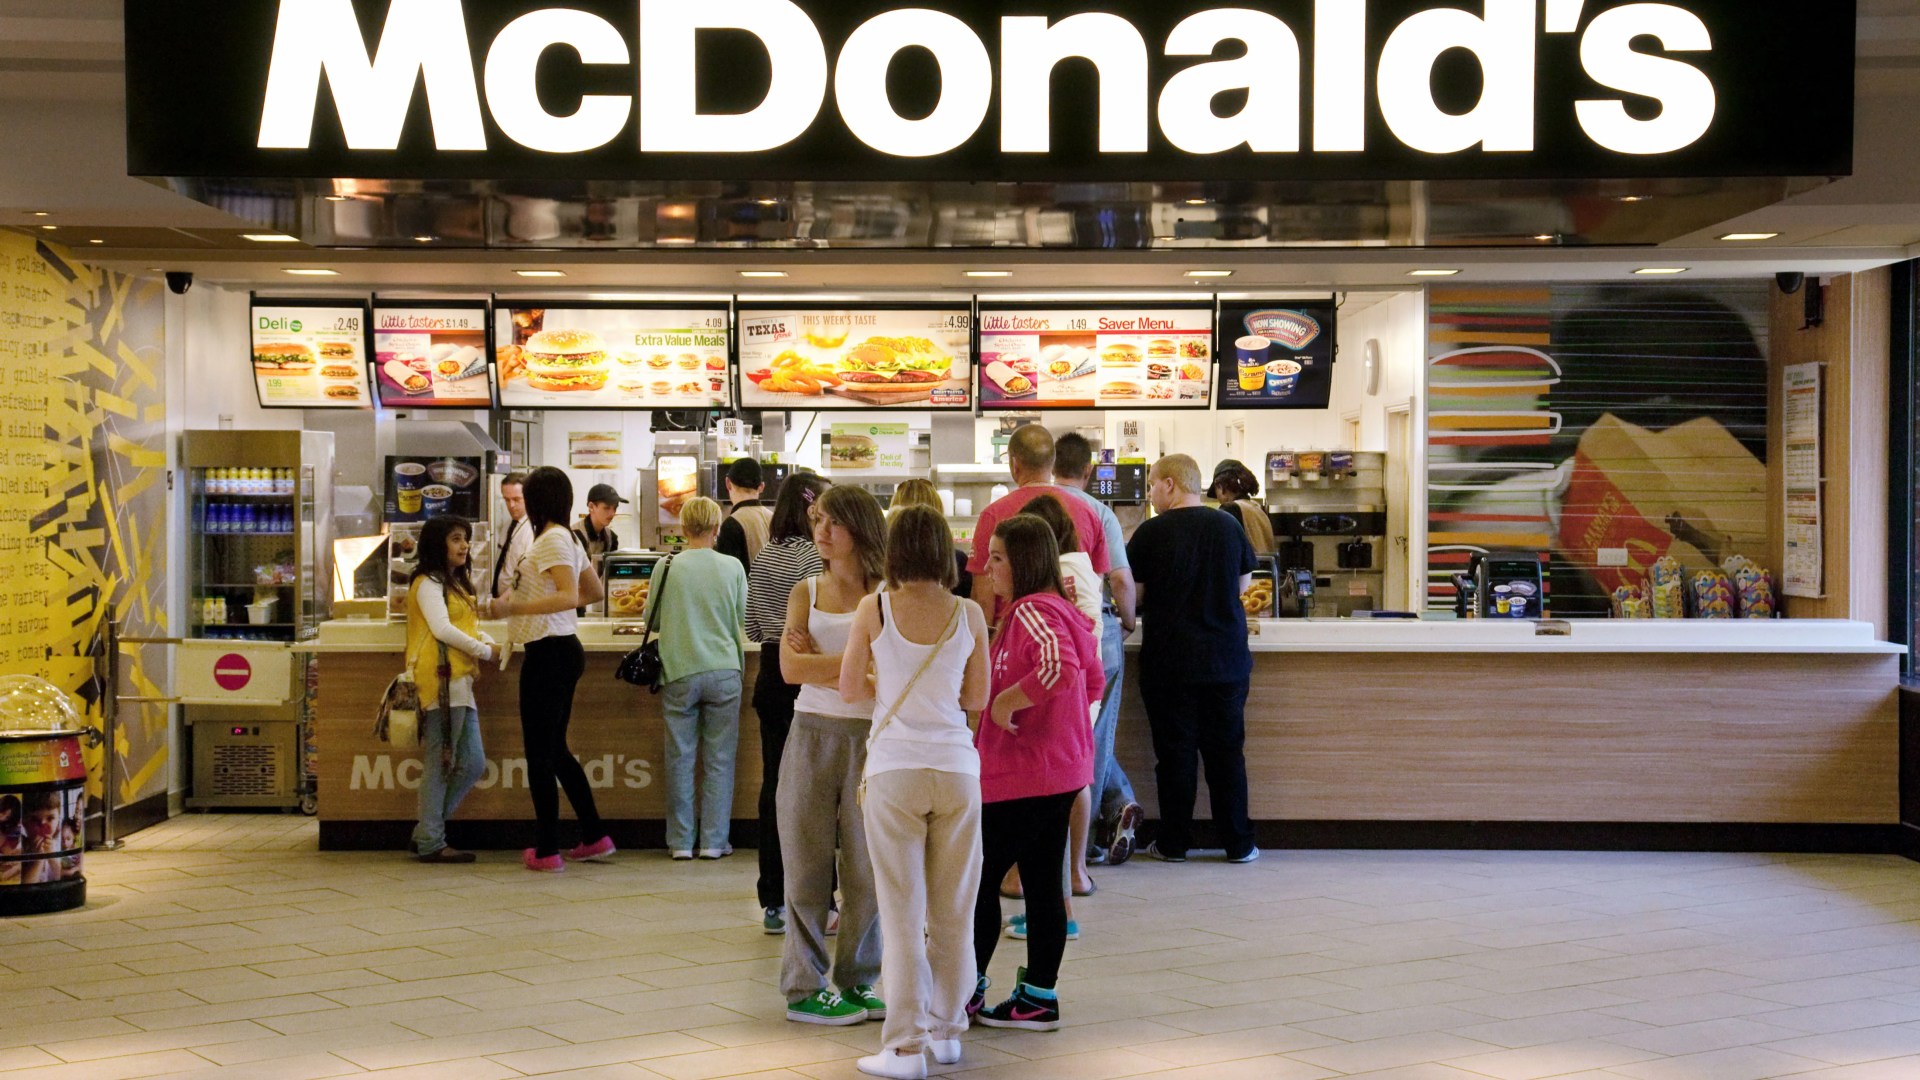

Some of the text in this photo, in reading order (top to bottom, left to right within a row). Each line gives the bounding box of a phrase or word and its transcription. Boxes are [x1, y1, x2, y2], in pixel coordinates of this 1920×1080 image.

[257, 0, 1717, 158] McDonald's
[259, 316, 288, 330] Deli
[408, 314, 445, 329] tasters
[445, 318, 469, 329] £1.49
[802, 315, 877, 325] THIS WEEK'S TASTE
[944, 315, 969, 329] £4.99
[1012, 314, 1050, 330] tasters
[1098, 317, 1174, 330] Saver Menu
[1253, 319, 1269, 329] NOW
[1269, 318, 1307, 336] SHOWING
[747, 323, 786, 337] TEXAS
[635, 334, 725, 347] Extra Value Meals
[349, 754, 652, 790] Mcond's
